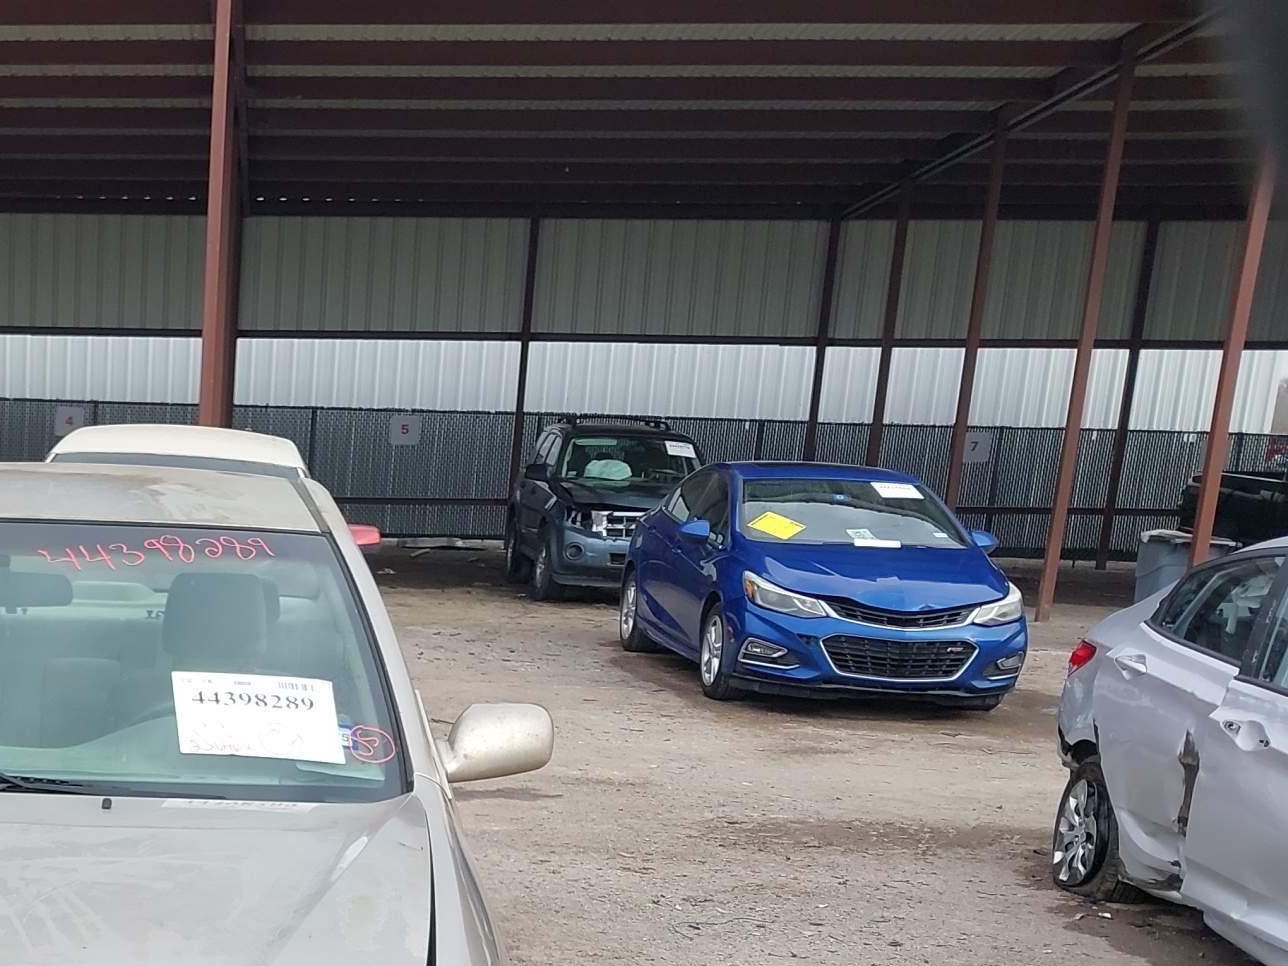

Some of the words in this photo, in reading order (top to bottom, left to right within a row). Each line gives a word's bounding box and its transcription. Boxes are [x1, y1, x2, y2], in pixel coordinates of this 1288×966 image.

[65, 416, 73, 425] 4
[401, 424, 409, 434] 5
[970, 441, 979, 452] 7
[37, 534, 276, 571] 44398289
[192, 690, 315, 711] 44398289
